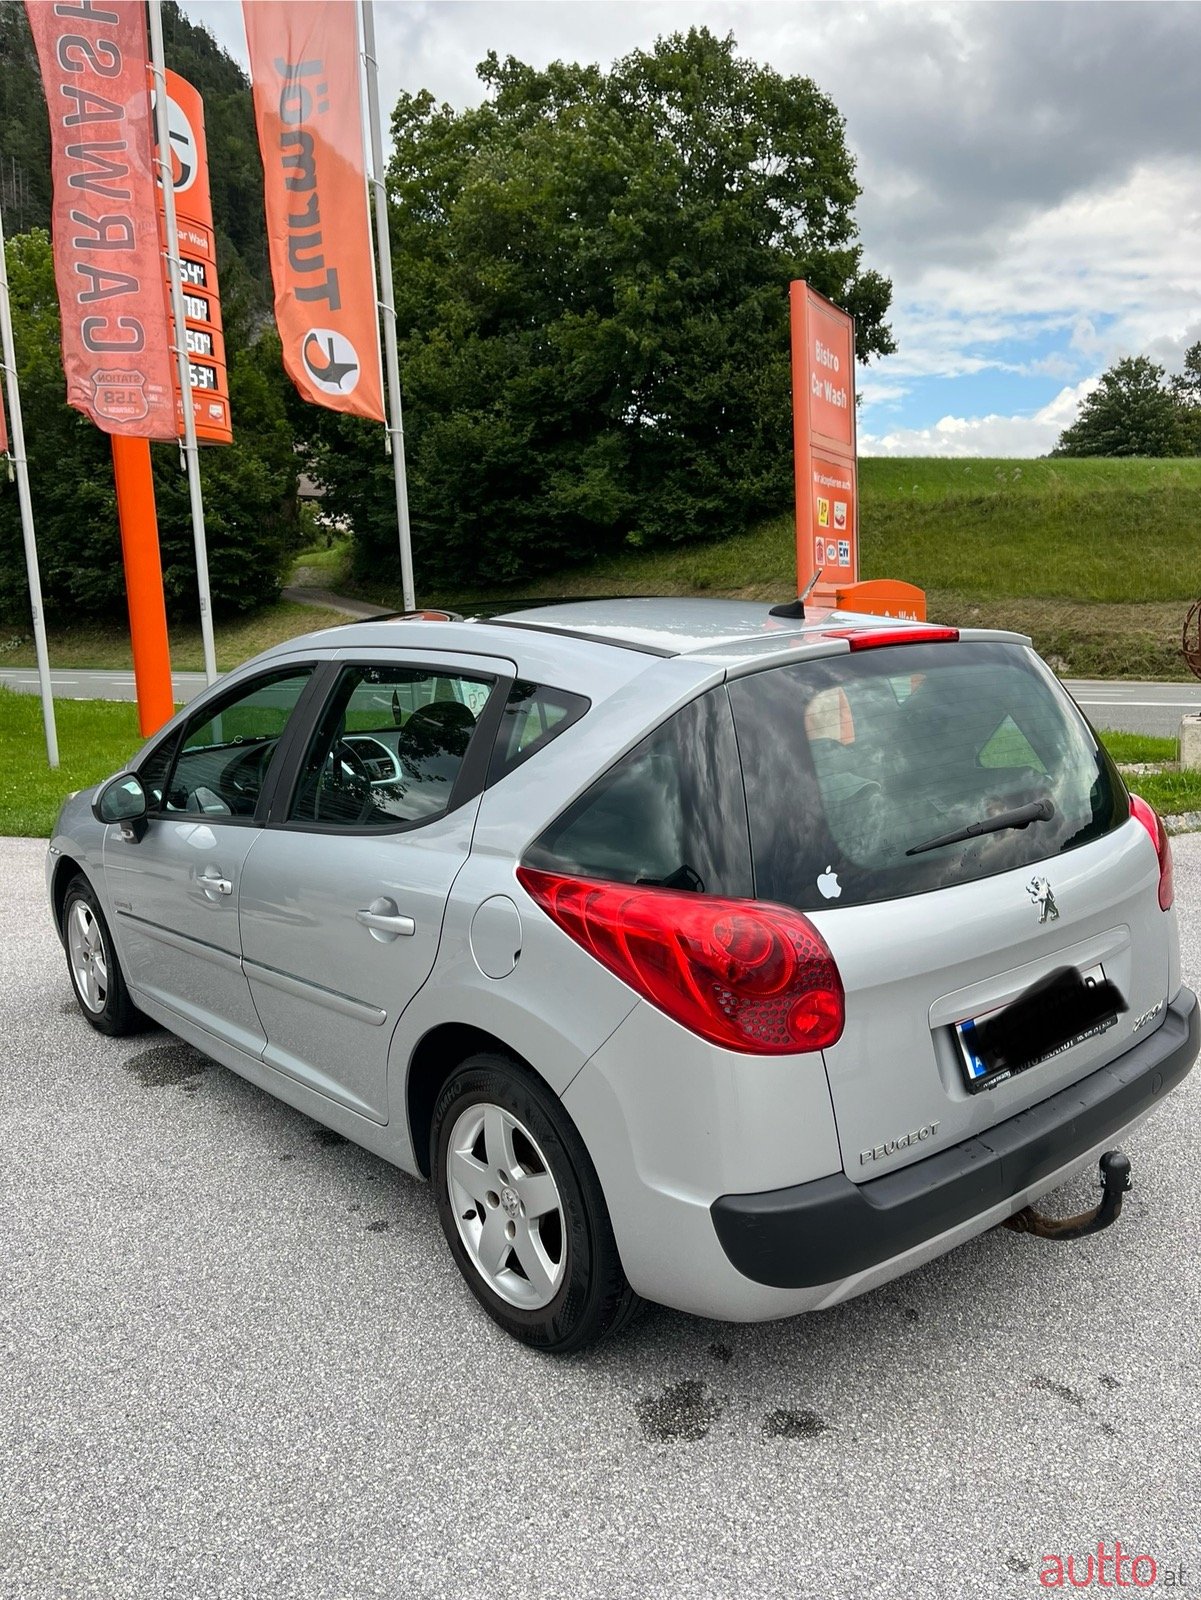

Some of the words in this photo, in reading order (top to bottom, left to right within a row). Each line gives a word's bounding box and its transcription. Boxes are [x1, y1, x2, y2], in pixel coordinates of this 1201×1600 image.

[188, 231, 208, 249] Wash
[815, 339, 839, 372] Bistro
[811, 371, 823, 398] Car
[824, 379, 847, 409] Wash
[859, 1120, 941, 1166] PEUGEOT
